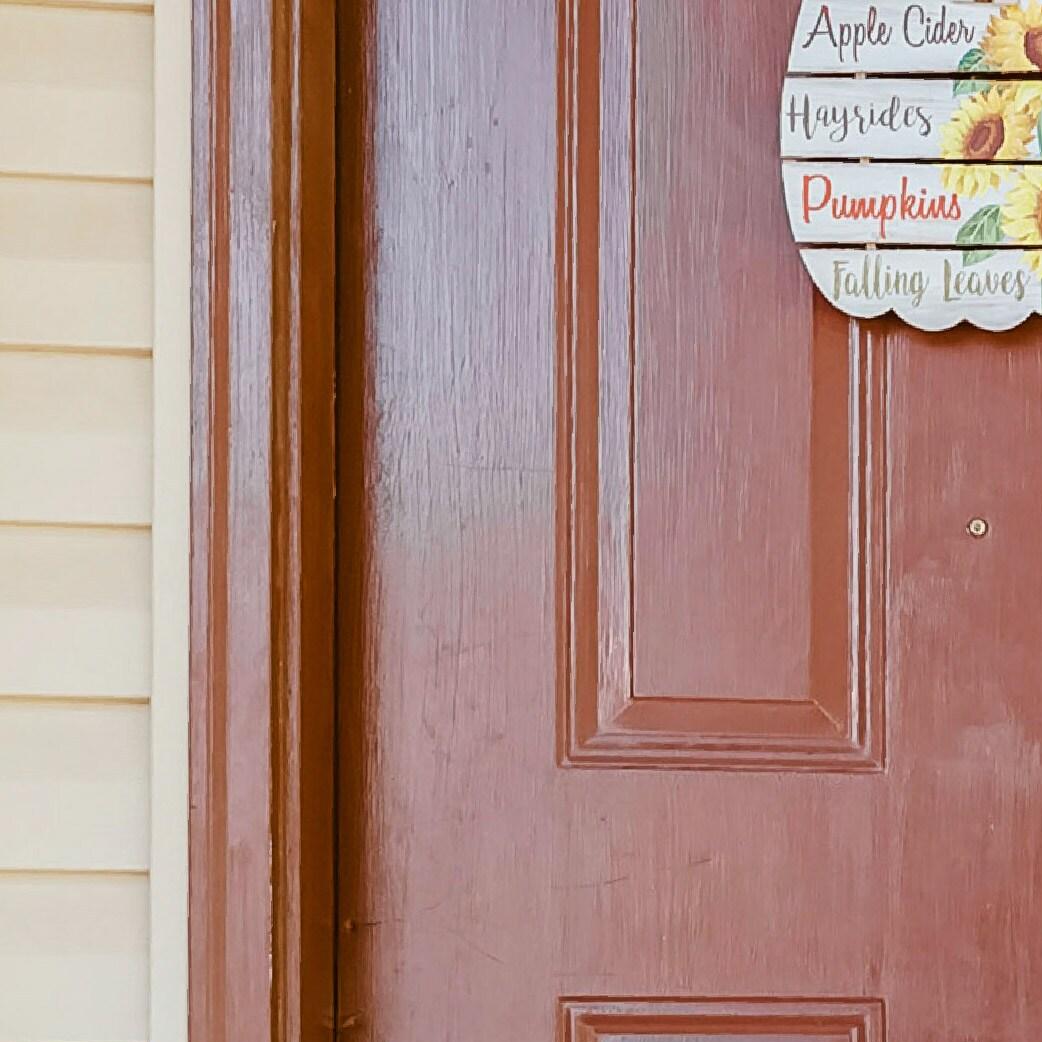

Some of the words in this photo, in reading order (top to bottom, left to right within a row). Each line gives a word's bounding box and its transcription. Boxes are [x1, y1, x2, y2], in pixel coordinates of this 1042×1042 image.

[802, 5, 892, 62] Apple
[903, 4, 975, 48] Cider
[786, 93, 932, 142] Hayrides
[802, 174, 962, 239] Pumpkins
[832, 254, 930, 307] Falling
[943, 259, 1031, 302] Leaves
